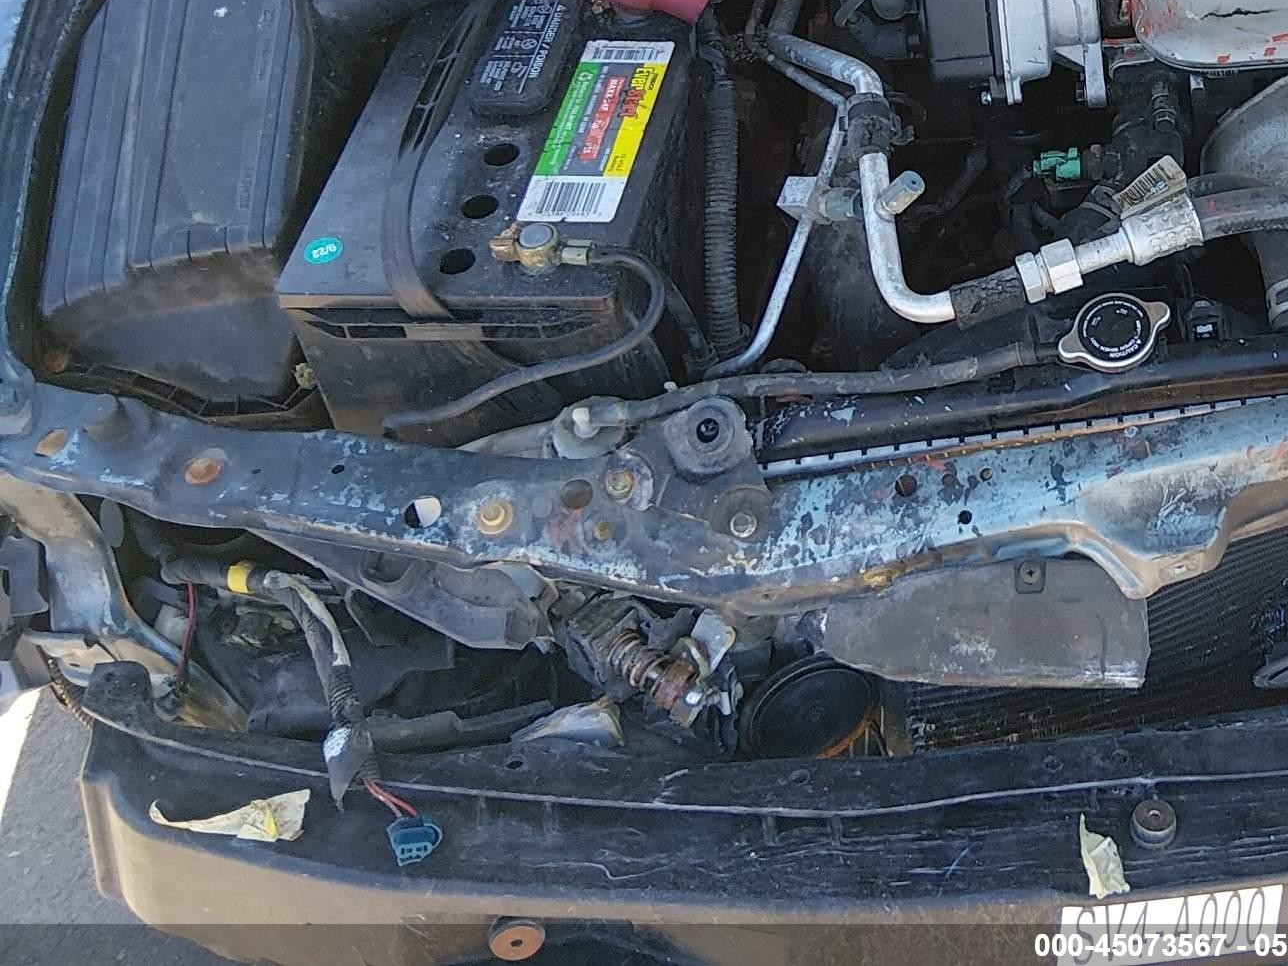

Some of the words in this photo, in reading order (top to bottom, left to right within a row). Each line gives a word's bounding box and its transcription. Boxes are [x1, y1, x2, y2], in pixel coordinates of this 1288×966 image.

[543, 12, 563, 43] DANGER
[528, 49, 548, 78] POISON
[312, 243, 337, 258] 9/22
[1090, 337, 1101, 348] HOT
[1109, 343, 1139, 358] CAUTION
